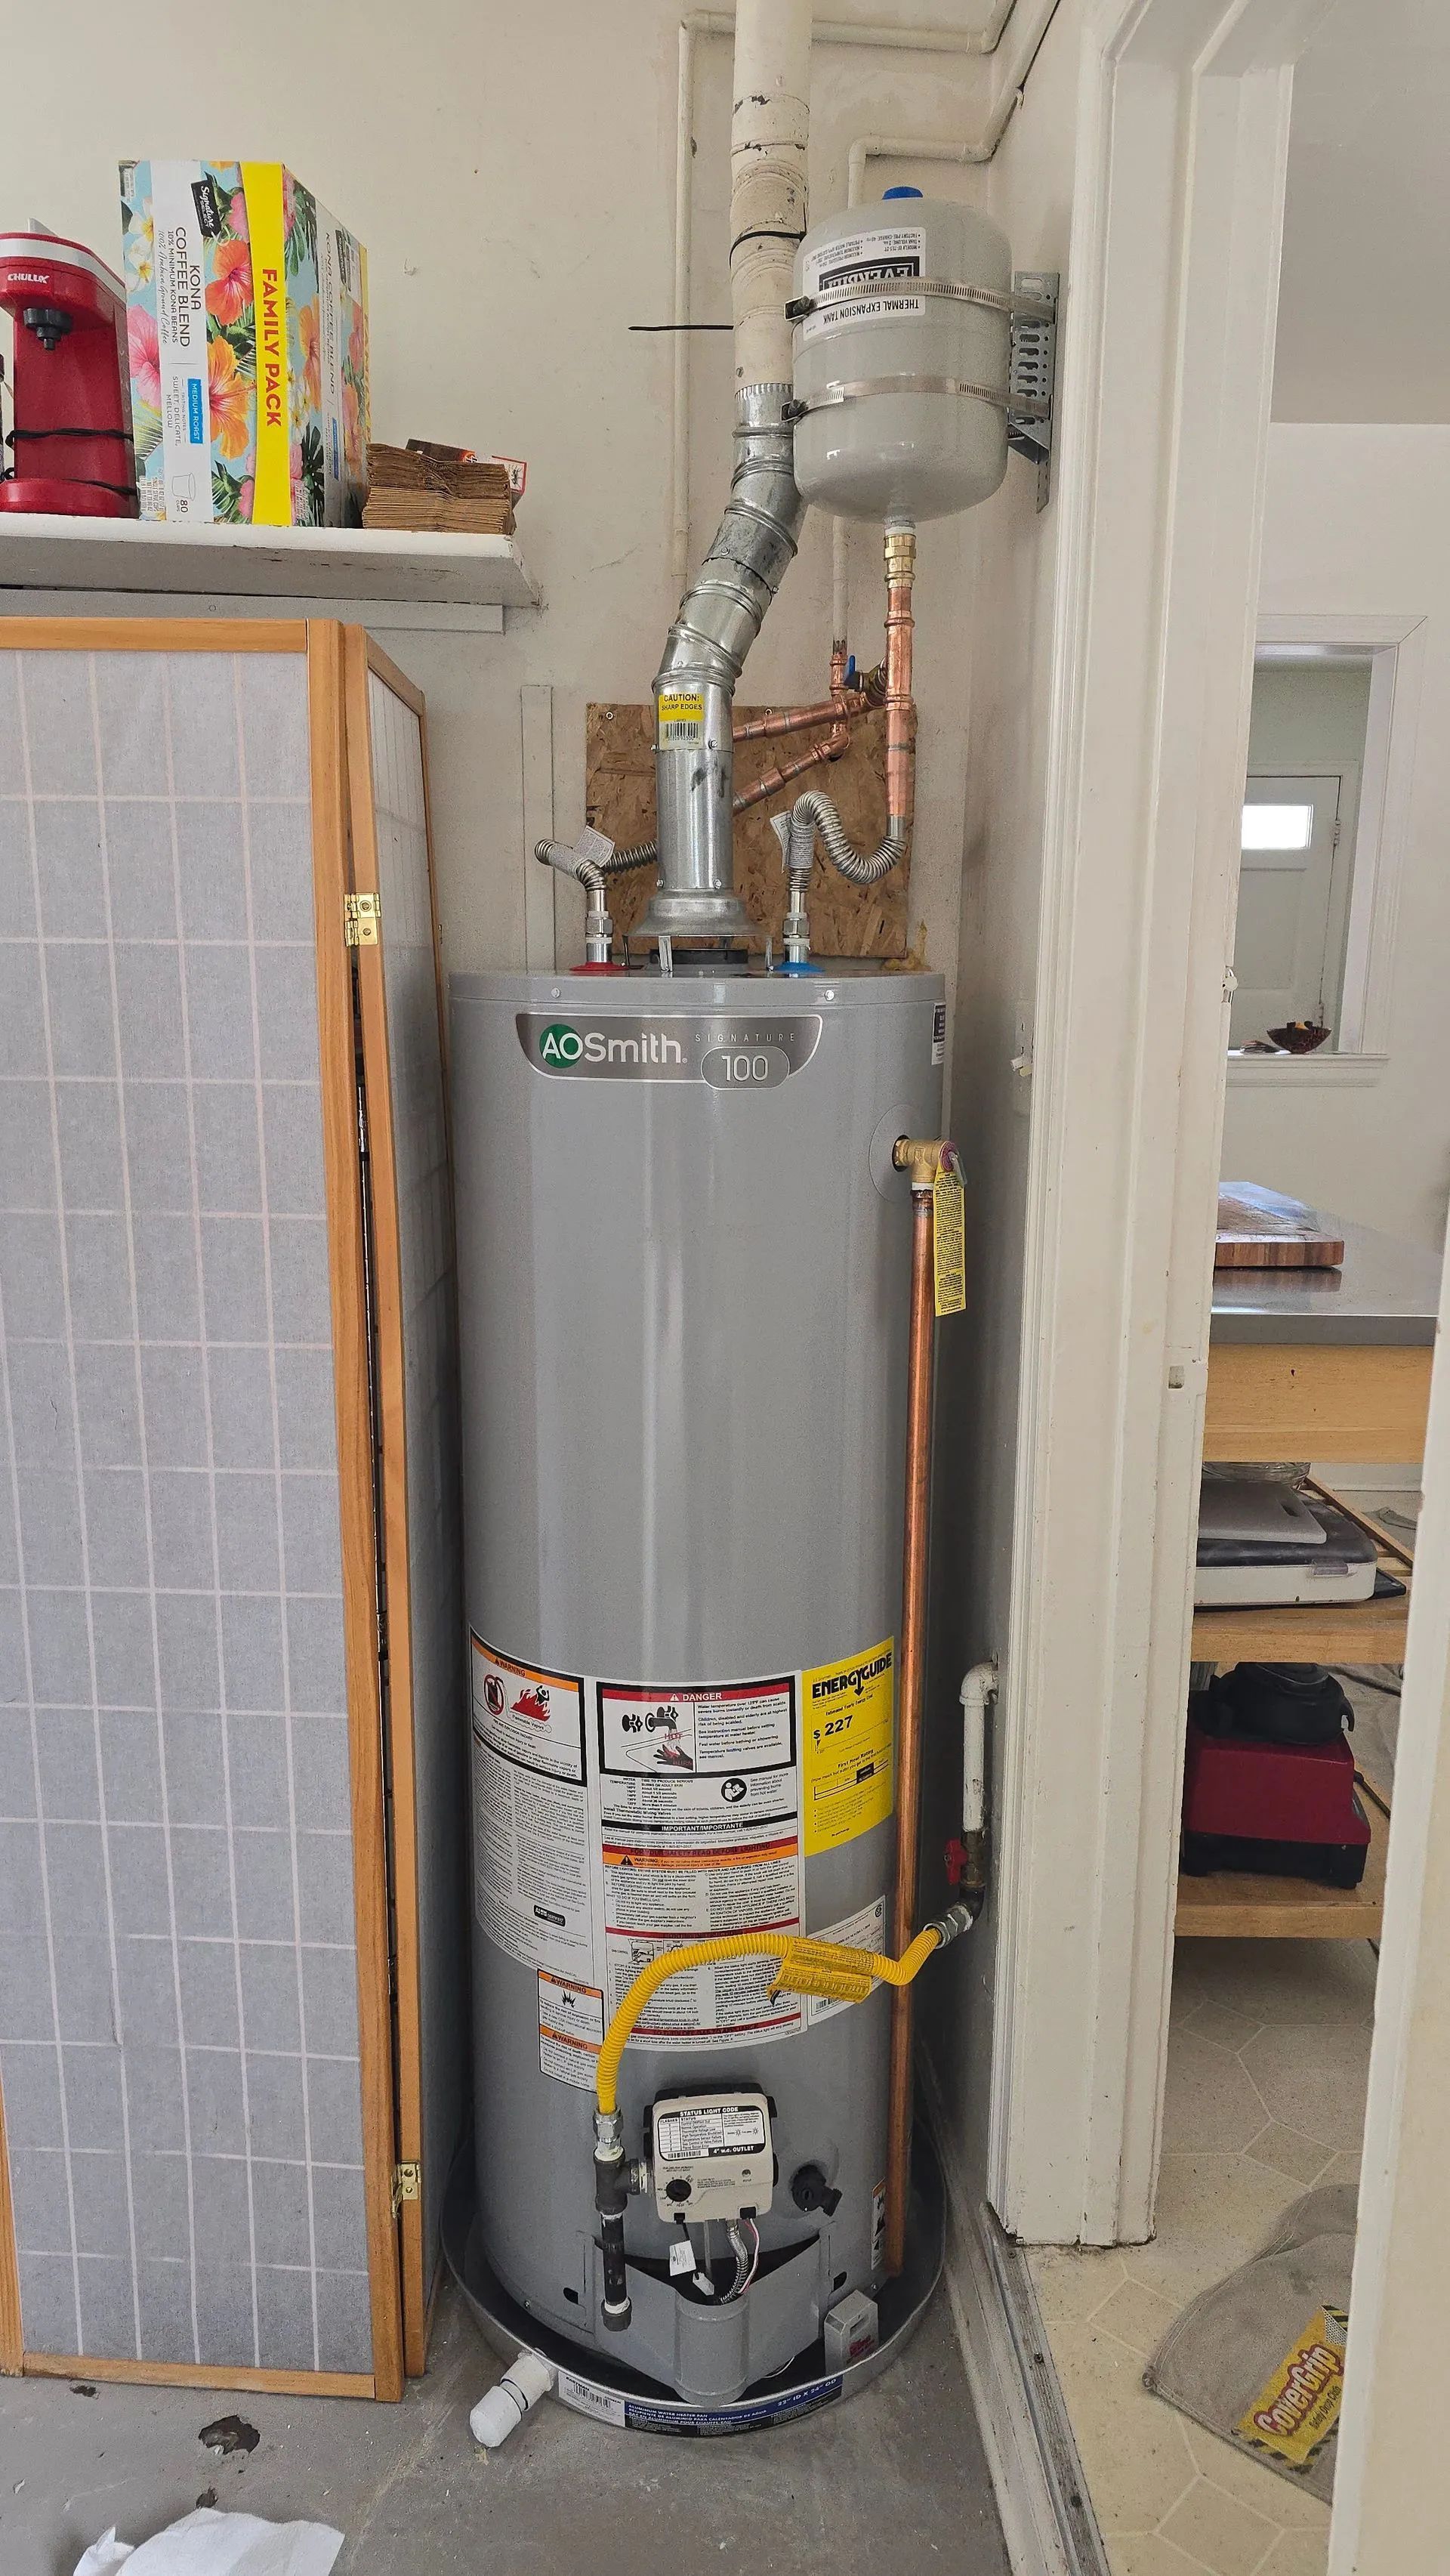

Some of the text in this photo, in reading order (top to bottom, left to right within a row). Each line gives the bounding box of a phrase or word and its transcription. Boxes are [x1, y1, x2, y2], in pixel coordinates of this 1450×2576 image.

[199, 186, 214, 228] Signature
[8, 273, 50, 283] CHULUX
[176, 227, 190, 347] COFFEE BLEND
[190, 265, 201, 310] KONA
[823, 299, 919, 325] THERMAL EXPANSION TANK
[262, 268, 282, 426] FAMILY PACK
[180, 499, 188, 513] 80
[695, 1033, 795, 1043] SIGNATURE
[721, 1055, 768, 1081] 100
[498, 1661, 526, 1678] WARNING
[813, 1652, 892, 1699] ENERGYGUIDE
[683, 1693, 722, 1701] DANGER
[826, 1705, 843, 1716] Estimated
[813, 1715, 853, 1739] $ 227
[838, 1760, 848, 1768] First
[861, 1749, 874, 1758] Rating
[662, 1822, 743, 1832] IMPORTANT/IMPORTANTE
[555, 1978, 587, 1994] WARNING
[557, 2034, 588, 2049] WARNING
[680, 2108, 702, 2117] STATUS
[825, 2379, 837, 2387] OD
[1255, 2345, 1343, 2435] CoverGrip
[628, 2405, 656, 2414] ALUMINUM
[628, 2408, 656, 2417] RECIPIENTE
[1310, 2408, 1326, 2429] Safety
[1319, 2399, 1334, 2414] Drop
